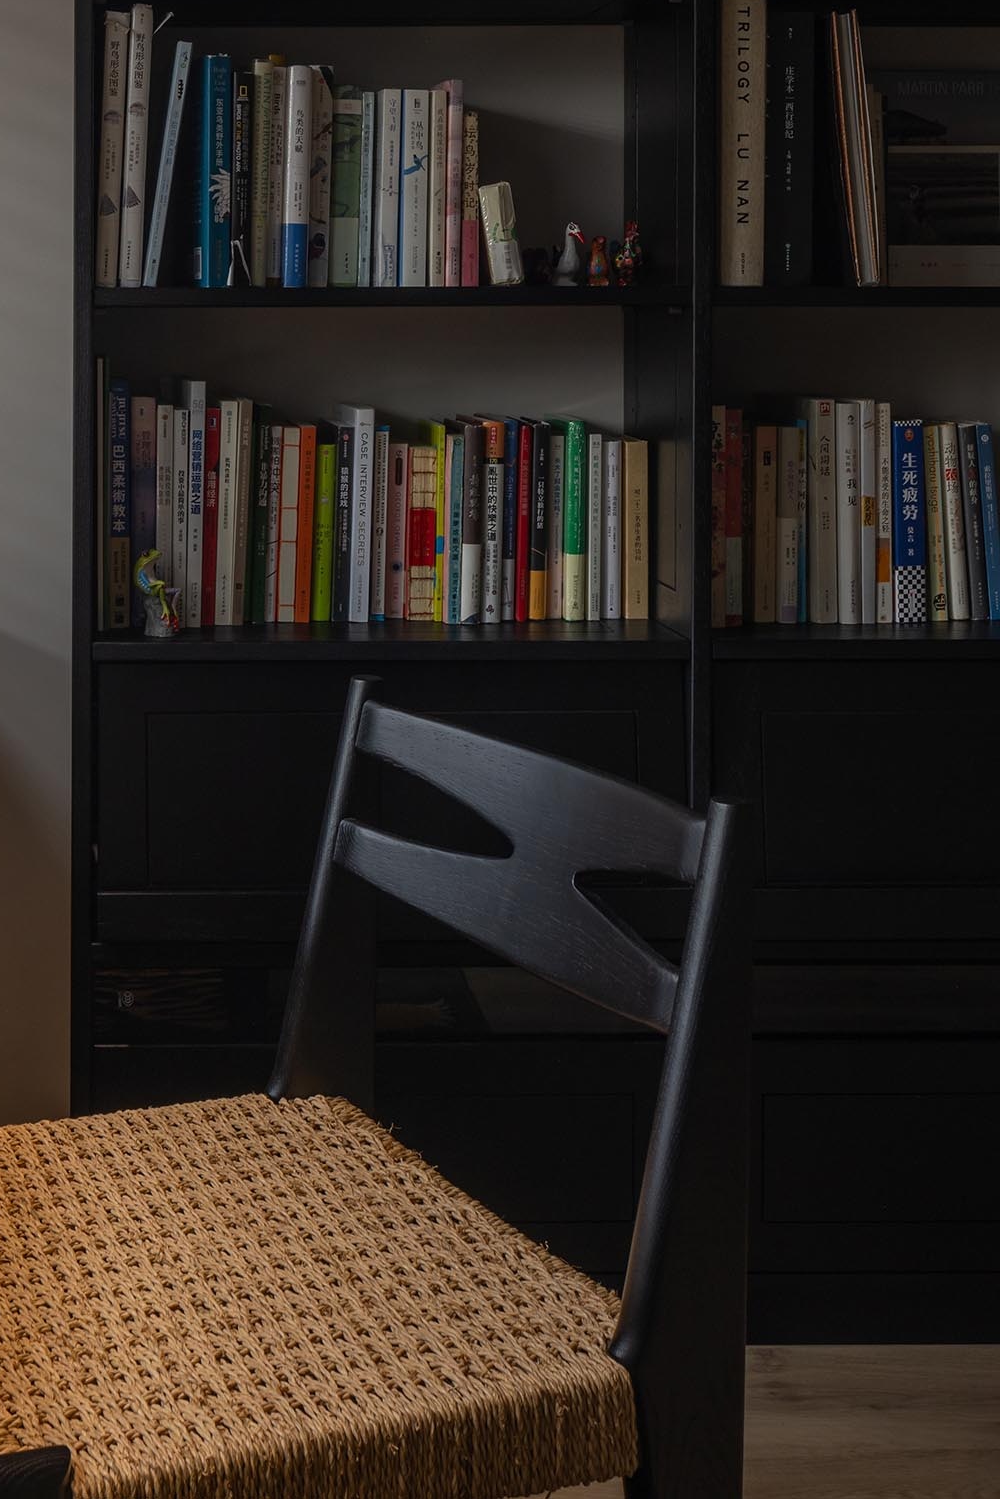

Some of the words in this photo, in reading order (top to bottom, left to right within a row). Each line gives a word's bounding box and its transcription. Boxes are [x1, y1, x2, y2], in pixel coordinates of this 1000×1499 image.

[737, 6, 750, 104] TRILOGY
[263, 73, 272, 105] LATIN
[897, 80, 948, 95] MARTIN
[952, 80, 984, 95] PARR
[236, 121, 241, 129] OF
[295, 109, 304, 153] 鸟类的天赋
[737, 132, 750, 160] LU
[261, 120, 271, 204] BIRDWATCHERS
[736, 180, 750, 224] NAN
[117, 396, 126, 440] JIU-JITSU
[360, 433, 368, 460] CASE
[927, 434, 938, 483] yoshiharu
[359, 464, 368, 517] INTERVIEW
[902, 452, 917, 521] 生死疲劳
[928, 486, 939, 513] tsuge
[357, 521, 365, 566] SECRETS
